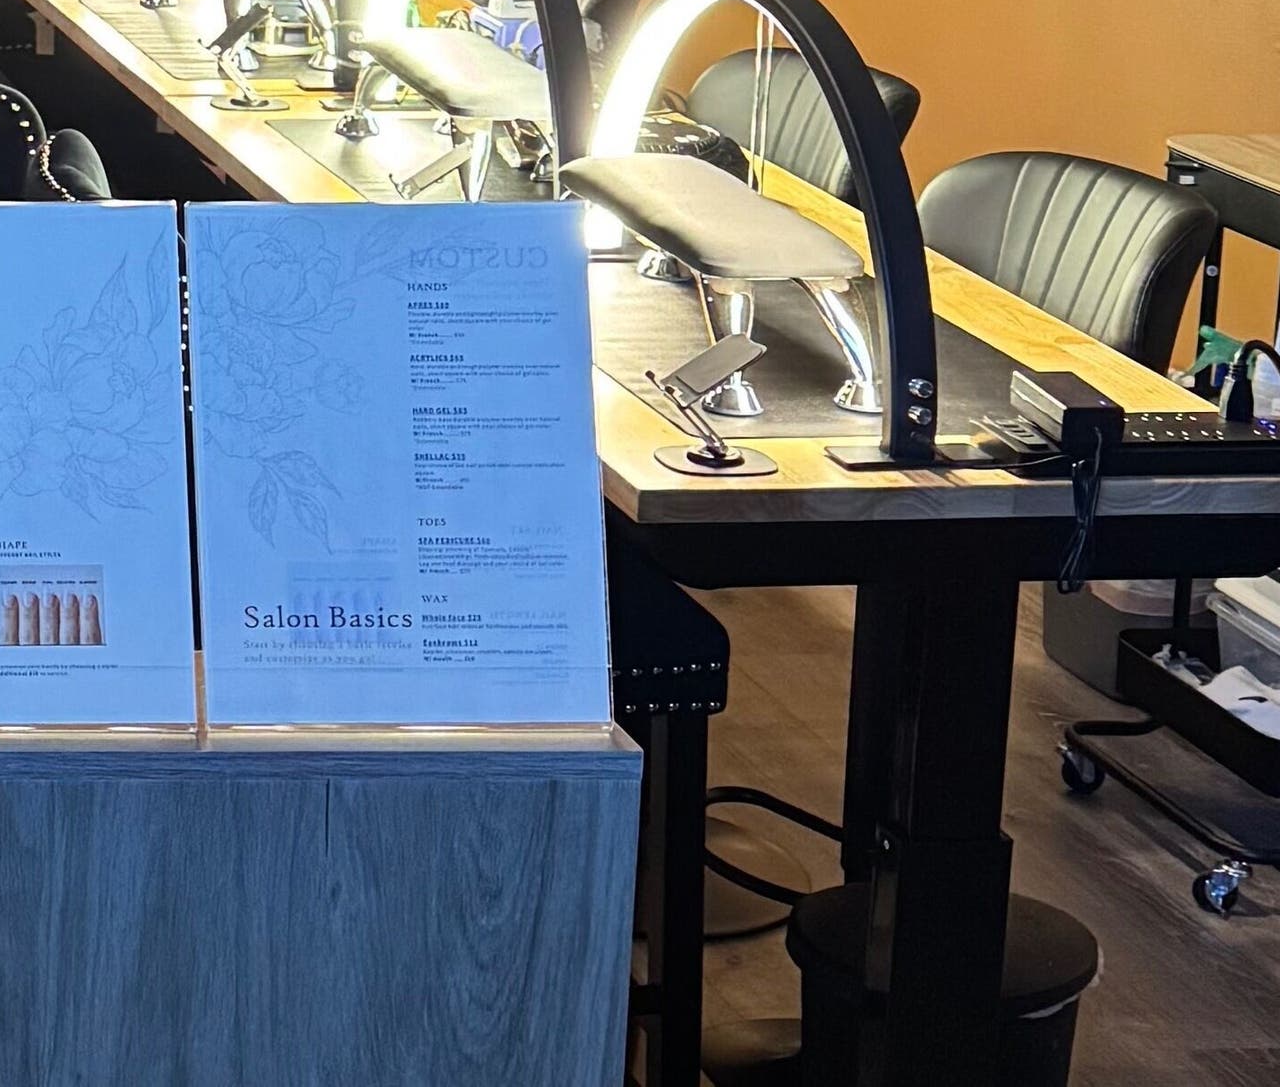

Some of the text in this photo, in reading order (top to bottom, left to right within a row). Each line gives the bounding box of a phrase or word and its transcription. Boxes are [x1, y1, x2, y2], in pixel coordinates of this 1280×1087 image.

[407, 282, 449, 292] HANDS
[417, 517, 447, 527] TOES
[421, 594, 449, 604] WAX
[244, 604, 413, 629] Salon Basics
